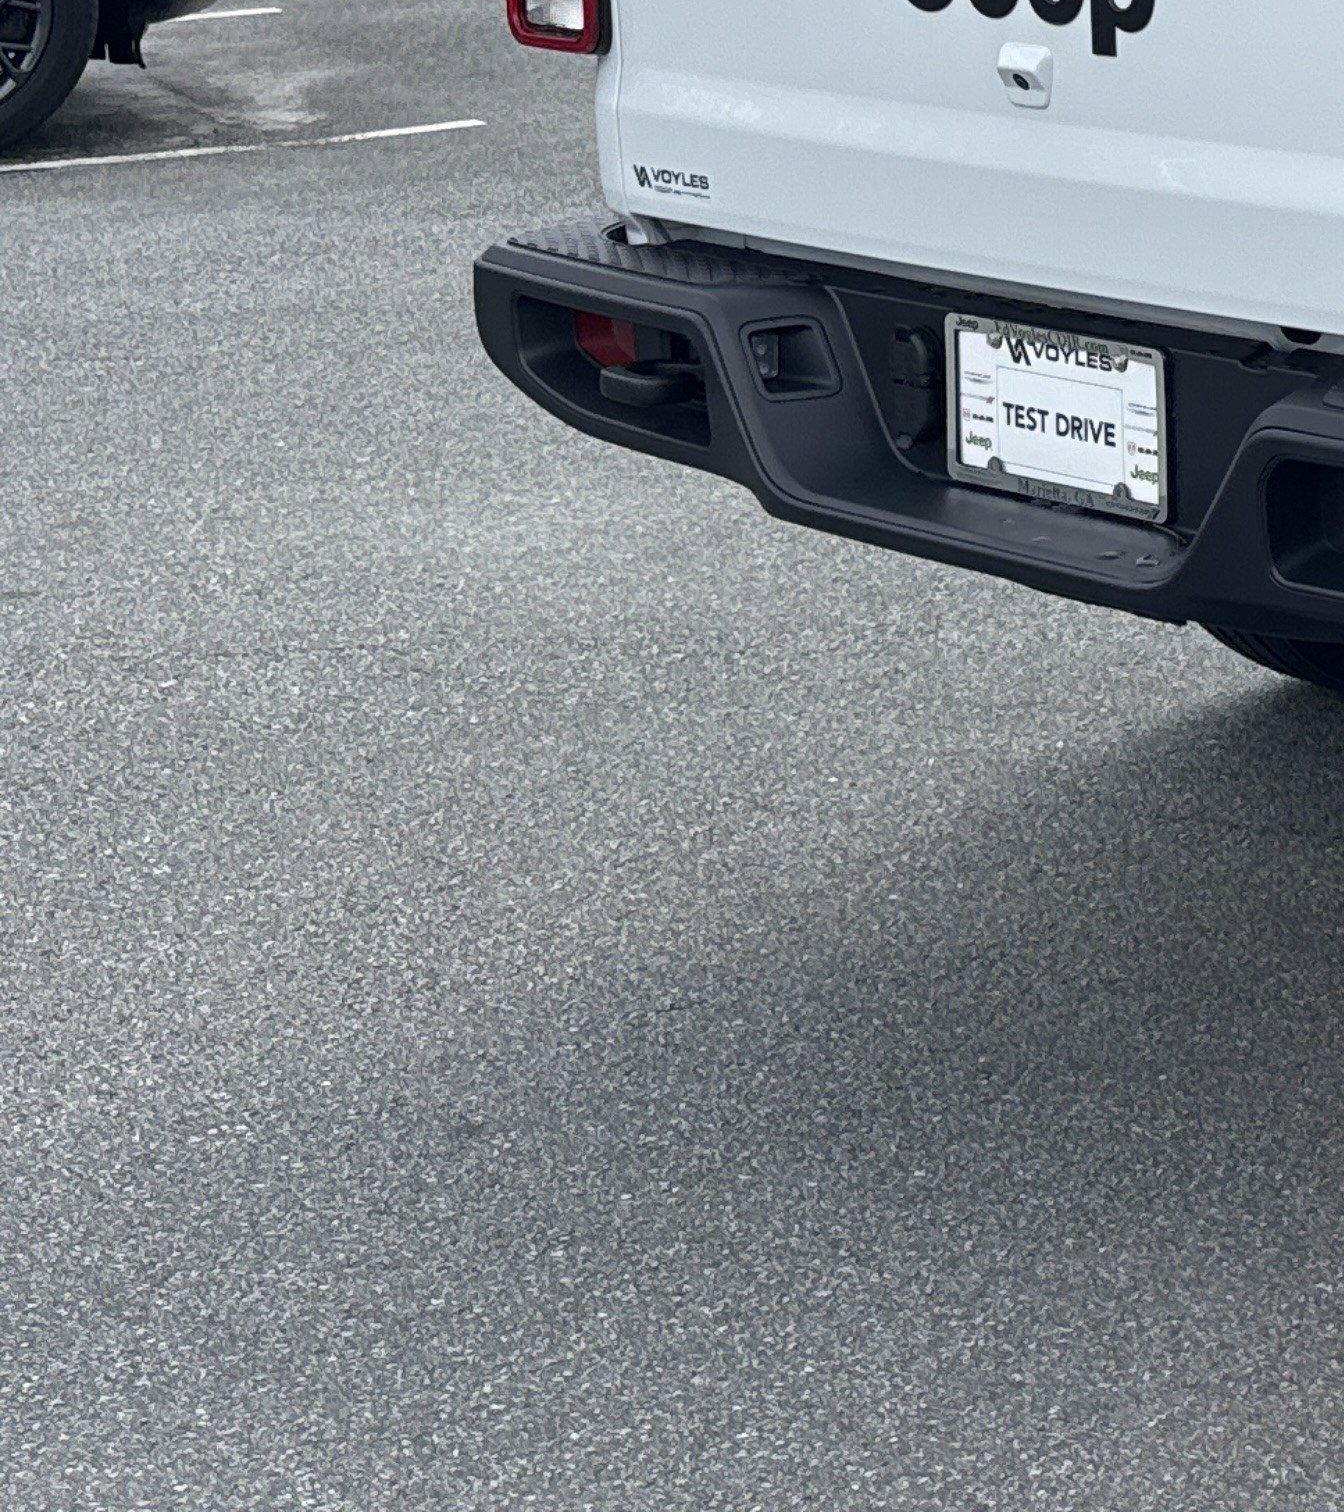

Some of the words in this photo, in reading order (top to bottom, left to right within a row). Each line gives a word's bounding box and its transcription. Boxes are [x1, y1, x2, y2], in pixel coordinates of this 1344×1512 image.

[650, 166, 710, 190] VOYLES
[1032, 340, 1113, 372] VOYLES
[1003, 401, 1049, 434] TEST
[1055, 412, 1117, 448] DRIVE
[965, 430, 993, 451] Jeep
